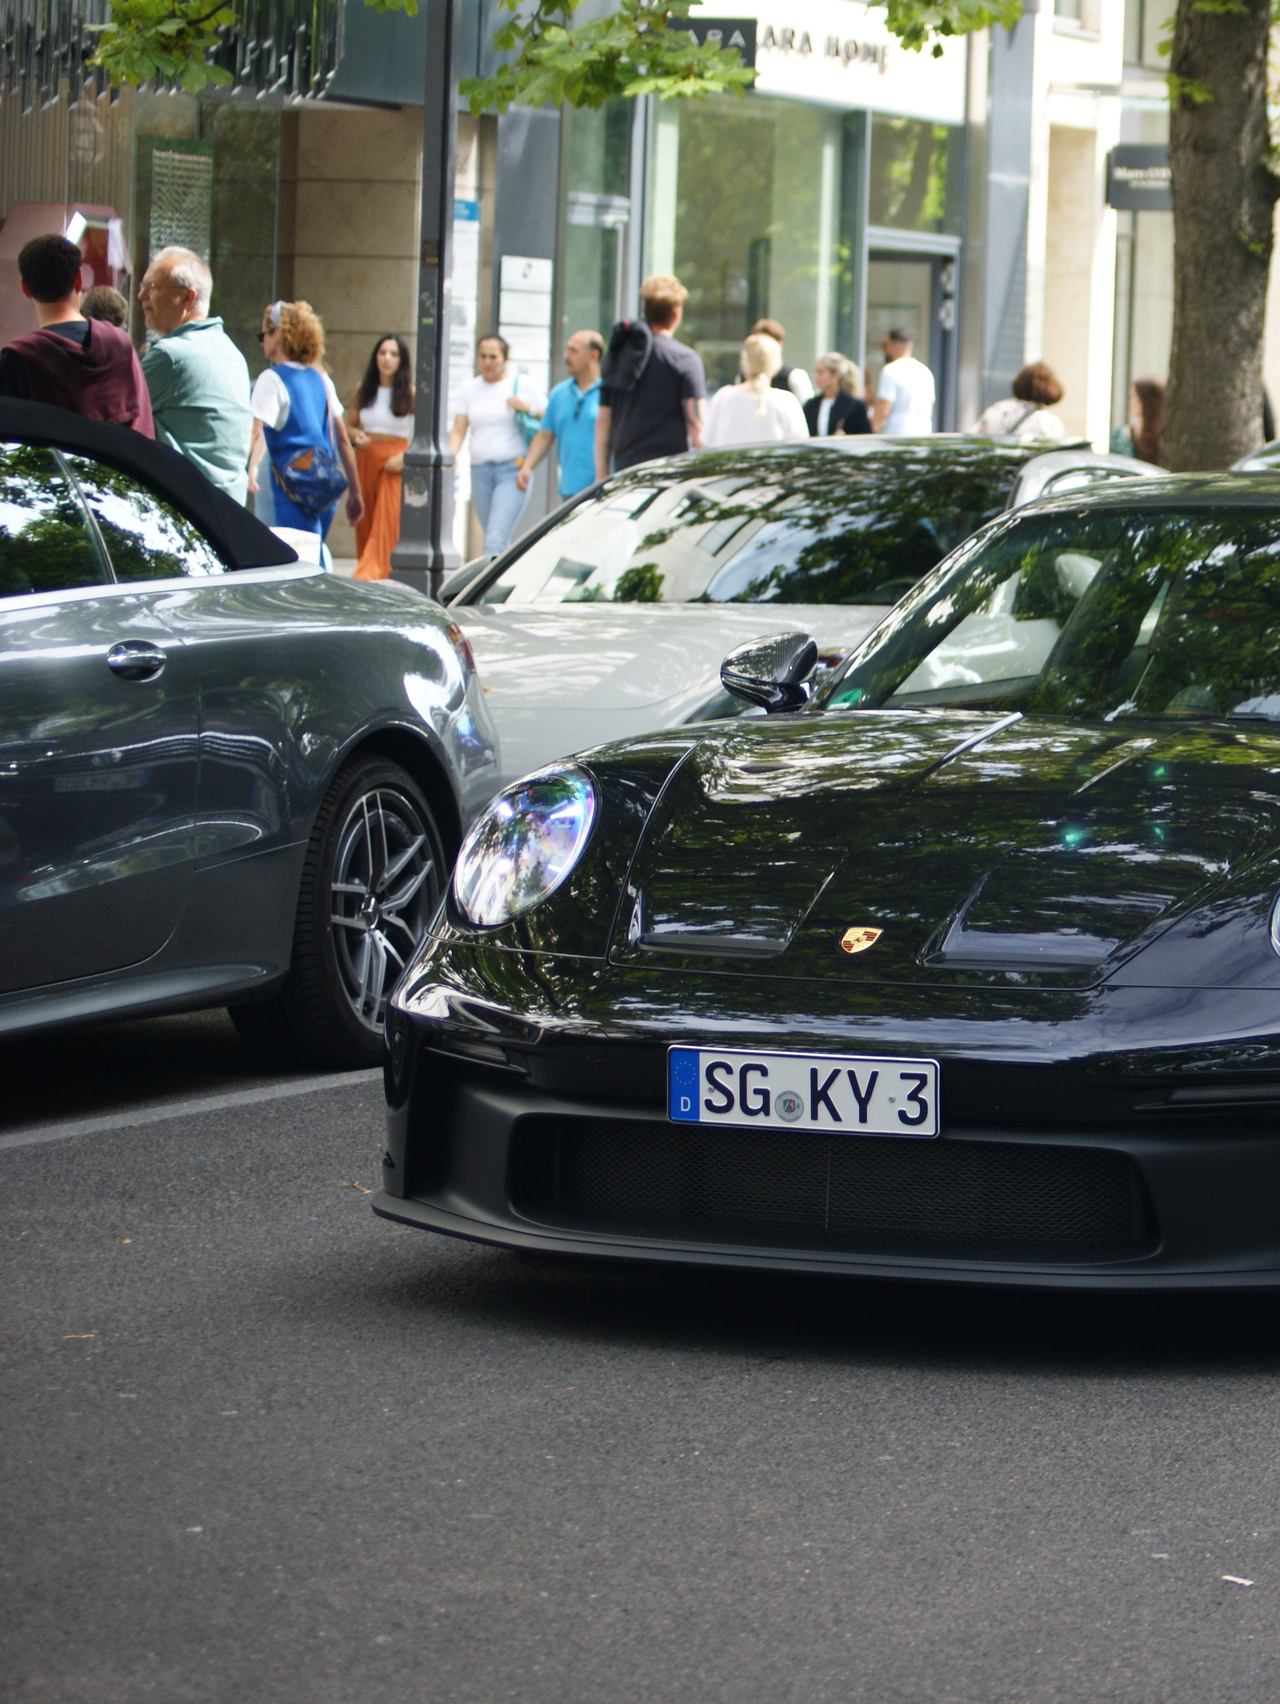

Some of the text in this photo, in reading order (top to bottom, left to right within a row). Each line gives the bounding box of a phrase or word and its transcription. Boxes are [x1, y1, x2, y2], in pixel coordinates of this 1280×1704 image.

[756, 25, 812, 56] ARA
[680, 1096, 691, 1112] D
[704, 1061, 771, 1117] SG
[809, 1067, 880, 1124] KY
[898, 1072, 929, 1126] 3
